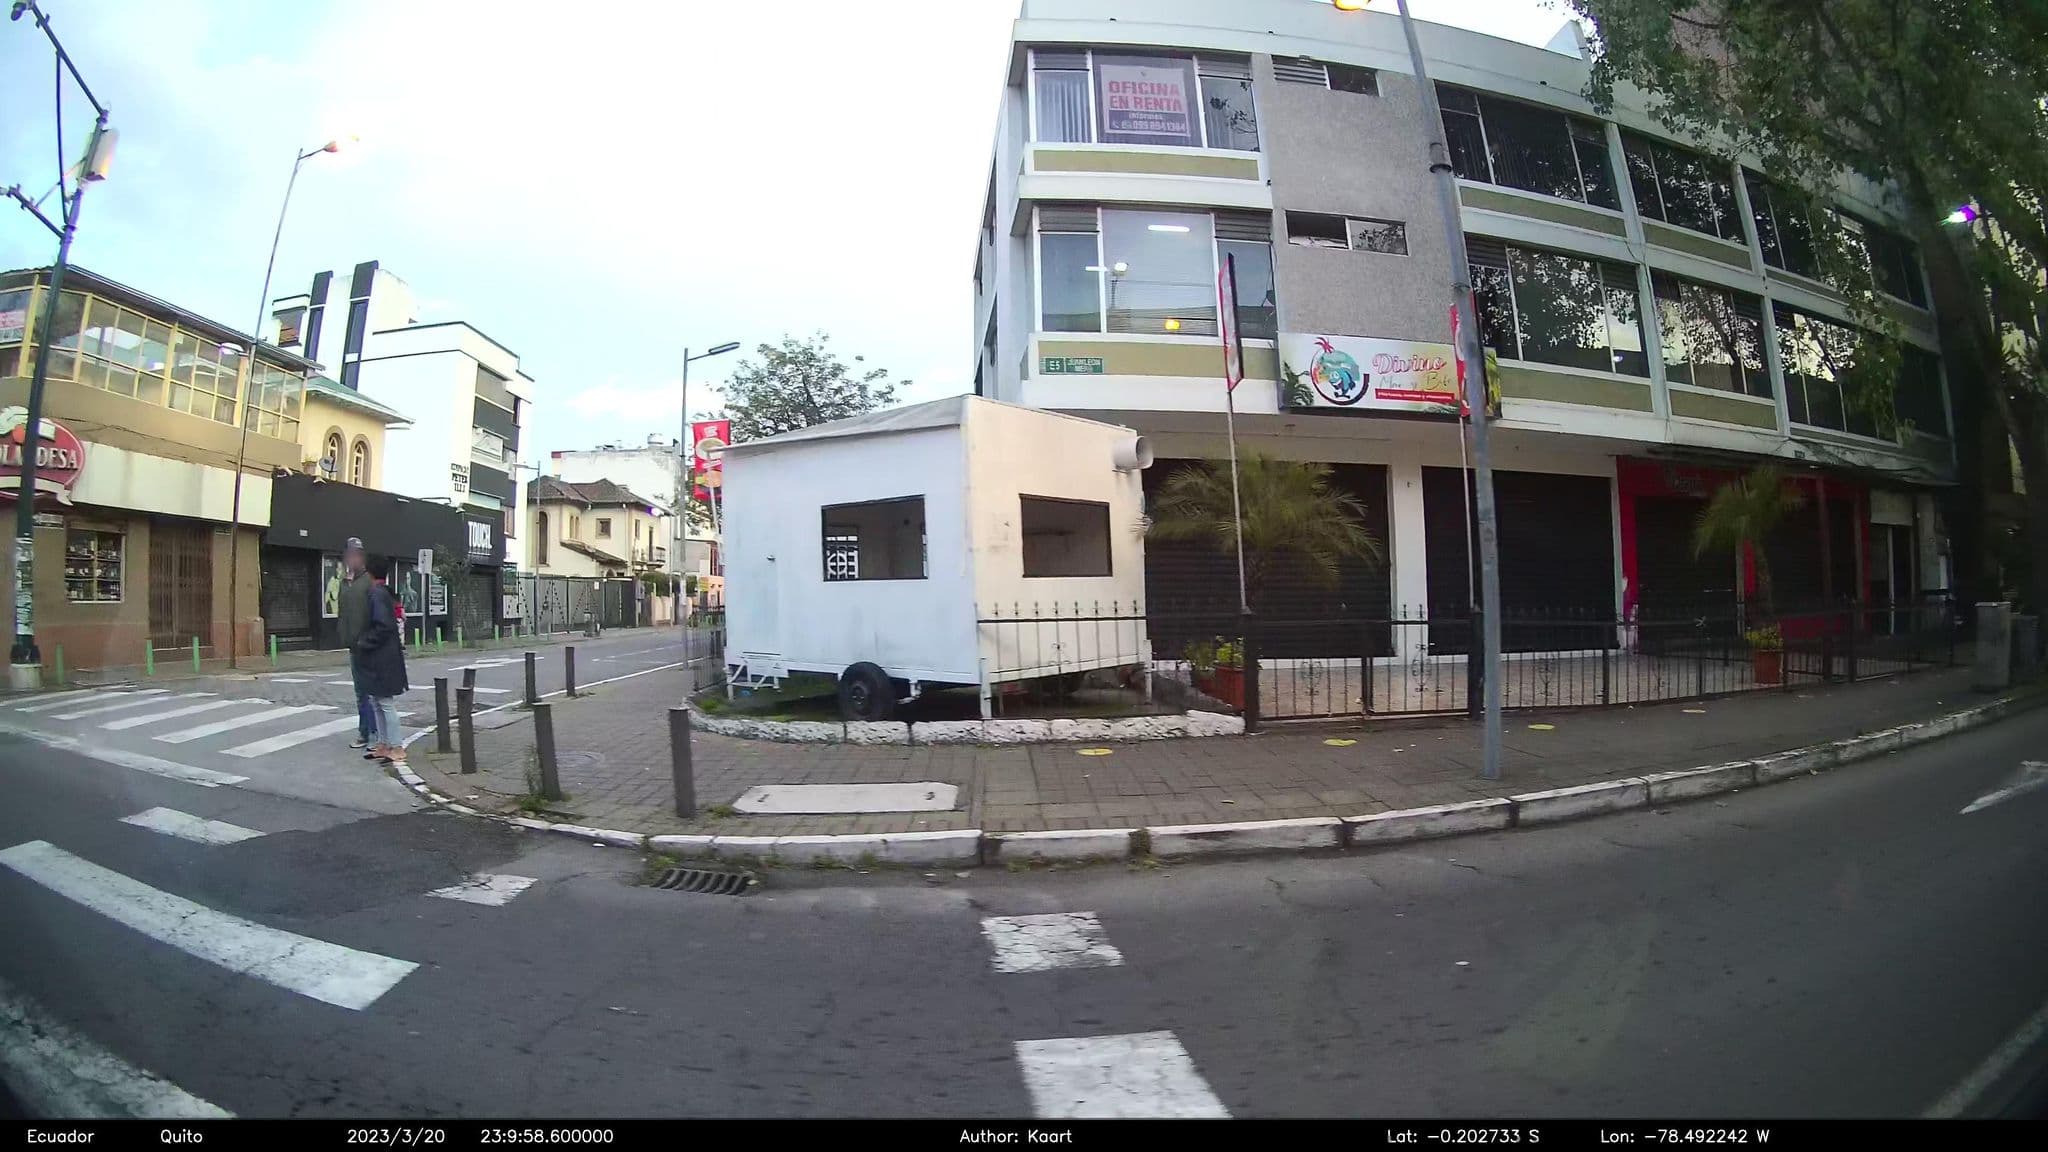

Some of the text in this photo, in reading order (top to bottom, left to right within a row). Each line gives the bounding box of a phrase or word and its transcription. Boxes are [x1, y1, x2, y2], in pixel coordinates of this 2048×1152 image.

[1109, 80, 1180, 96] OFICINA
[1110, 95, 1182, 112] EN RENTA
[1372, 353, 1447, 374] Divino
